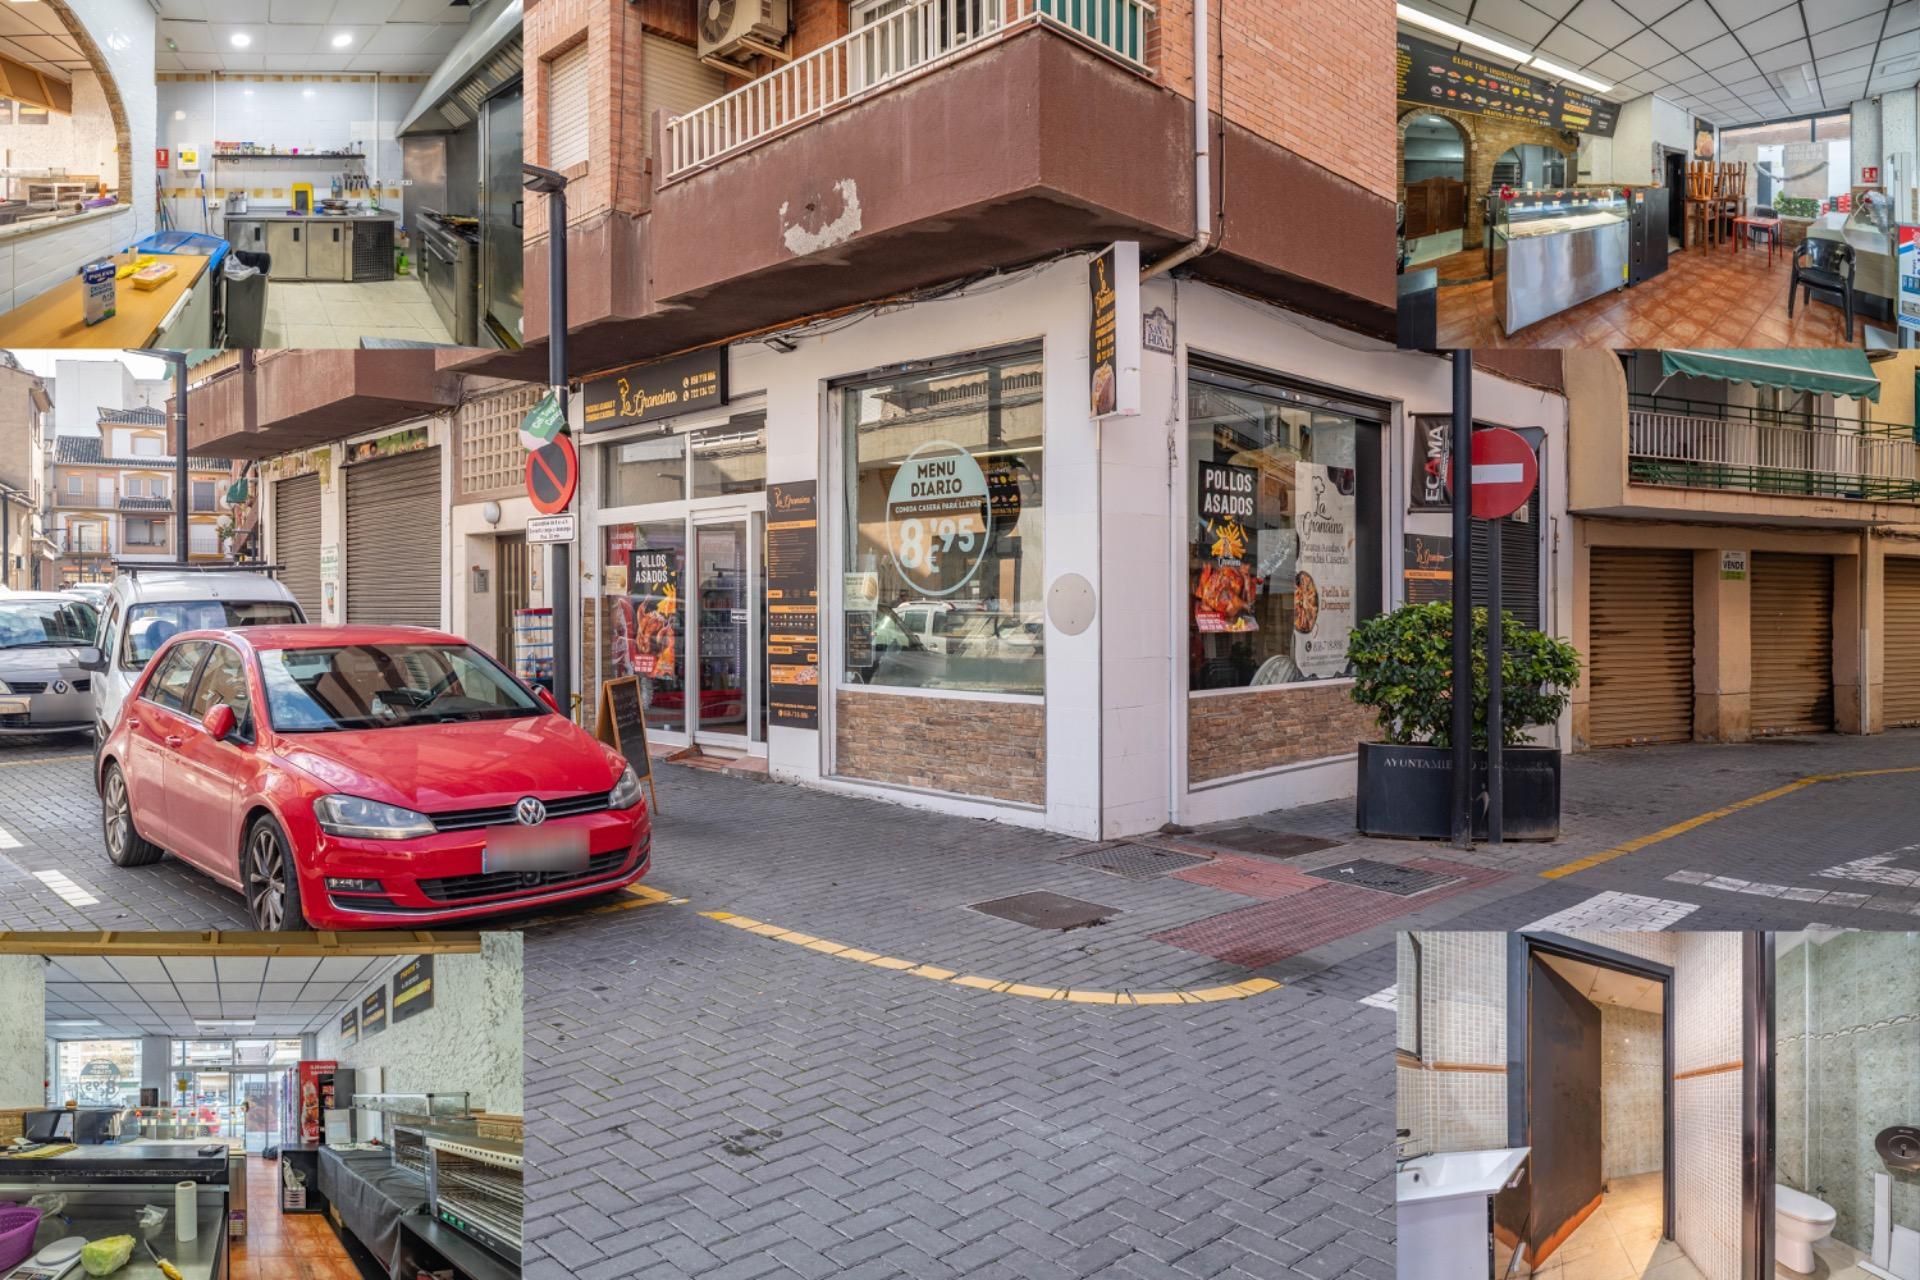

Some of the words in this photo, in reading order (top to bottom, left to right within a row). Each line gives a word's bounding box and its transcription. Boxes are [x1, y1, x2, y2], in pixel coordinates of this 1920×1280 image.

[917, 461, 956, 479] MENU
[1424, 425, 1444, 501] ECAMA
[911, 478, 962, 497] DIARIO
[1206, 469, 1252, 493] POLLOS
[942, 502, 958, 510] PARA
[1204, 492, 1253, 516] ASADOS
[635, 554, 667, 569] POLLOS
[1723, 559, 1744, 569] VENDE
[634, 570, 668, 584] ASADOS
